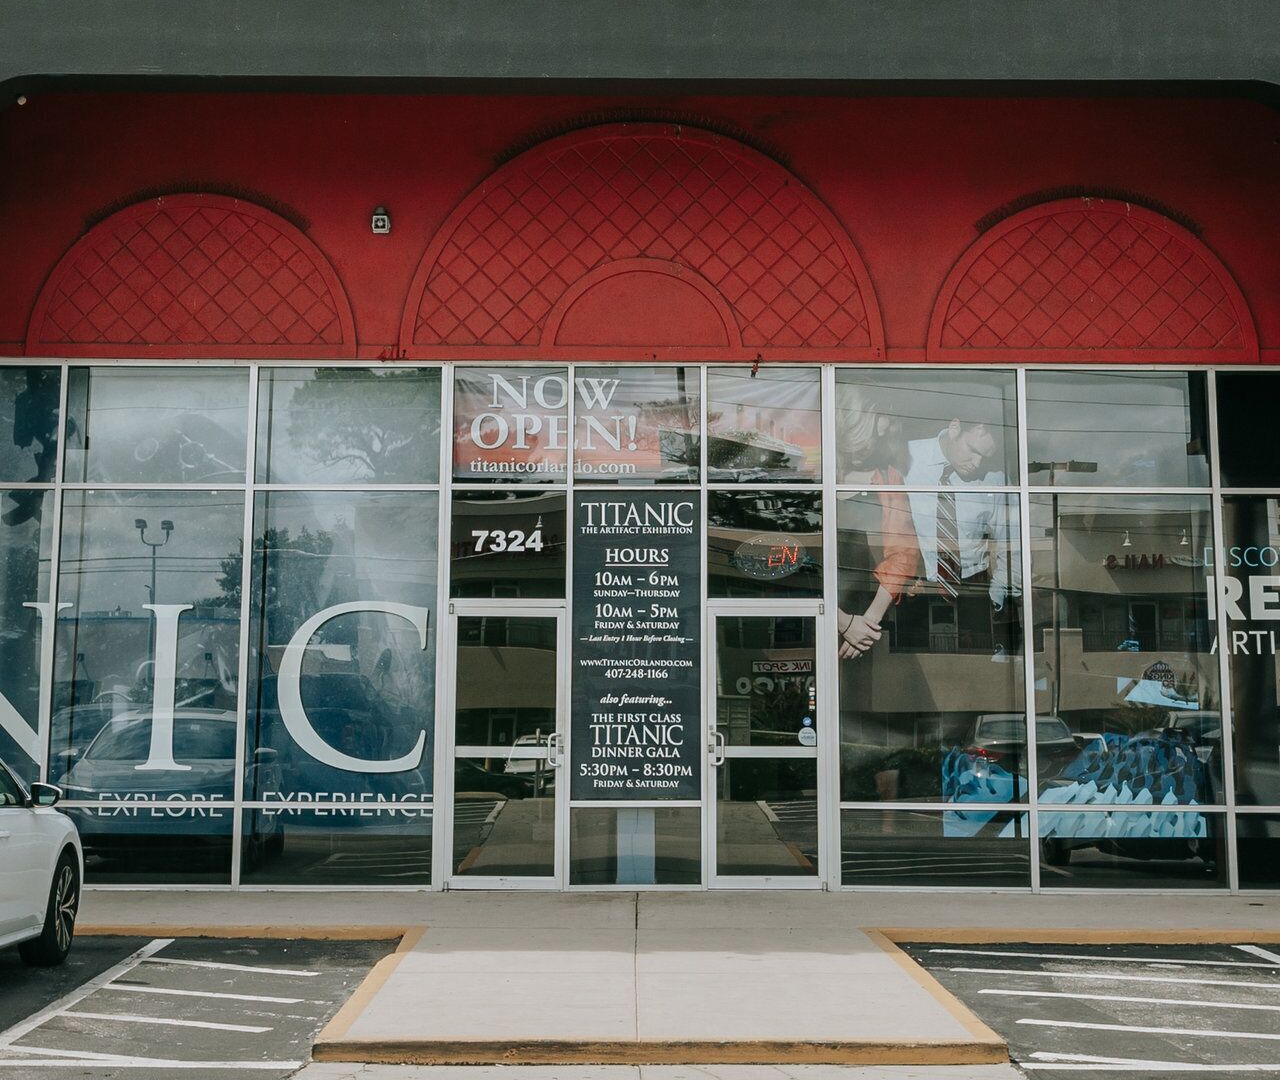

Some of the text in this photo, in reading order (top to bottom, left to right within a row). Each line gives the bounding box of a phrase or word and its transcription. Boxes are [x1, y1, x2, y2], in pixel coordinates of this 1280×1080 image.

[487, 373, 622, 411] NOW
[470, 412, 638, 451] OPEN!
[580, 502, 694, 527] TITANIC
[471, 530, 544, 552] 7324
[605, 548, 669, 563] HOURS
[594, 571, 632, 586] 10AM
[649, 571, 679, 586] 6PM
[595, 603, 633, 618] 10AM
[650, 603, 679, 618] 5PM
[626, 621, 634, 629] &
[603, 634, 620, 643] Entry
[643, 635, 661, 643] Before
[663, 635, 685, 644] Closing
[604, 669, 668, 679] 407-248-1166
[600, 693, 672, 706] also featuring...
[591, 713, 681, 723] THE FIRST CLASS
[589, 724, 684, 746] TITANIC
[591, 747, 680, 758] DINNER GALA
[580, 763, 628, 776] 5:30PM
[643, 763, 693, 776] 8:30PM
[626, 779, 634, 788] &
[98, 791, 433, 817] EXPLORE EXPERIENCE
